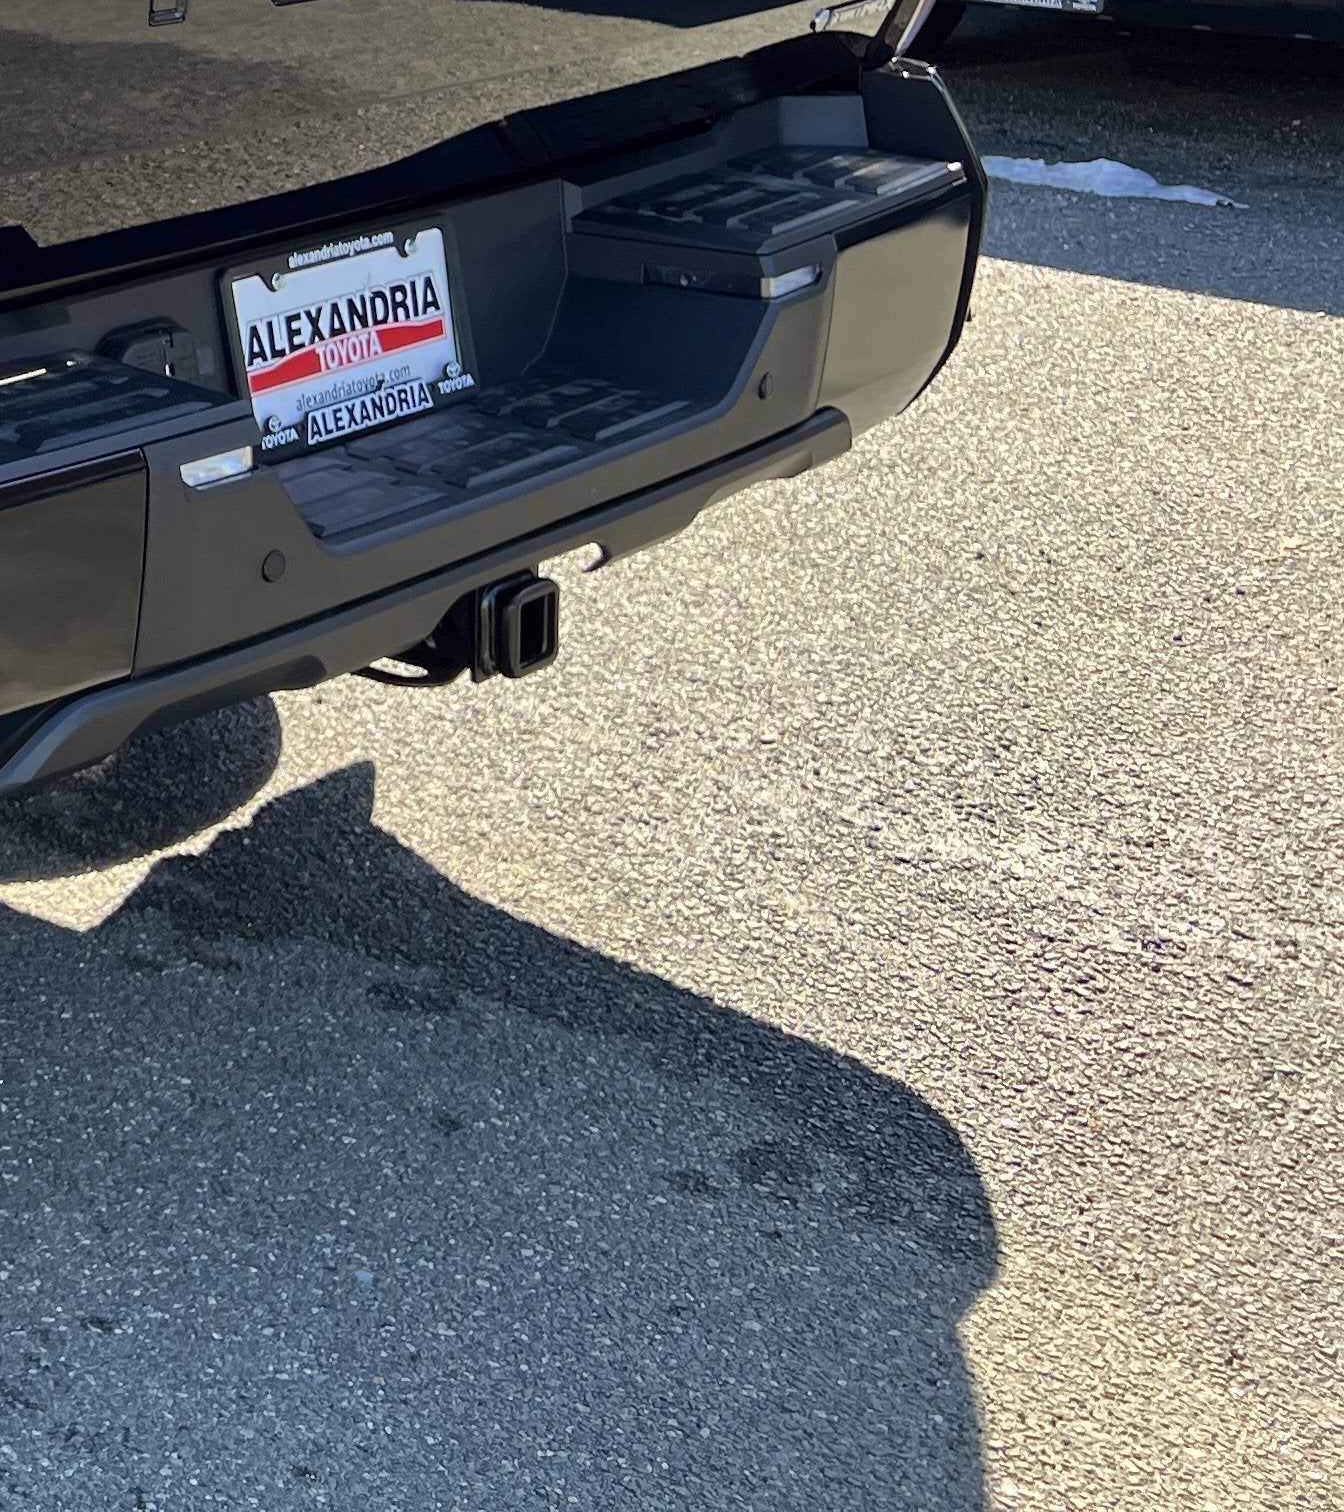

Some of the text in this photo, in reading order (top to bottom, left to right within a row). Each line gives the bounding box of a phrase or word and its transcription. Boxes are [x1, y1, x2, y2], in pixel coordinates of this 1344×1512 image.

[288, 230, 395, 269] alexandriatoyota.com
[246, 275, 442, 368] ALEXANDRIA
[315, 329, 383, 373] TOYOTA
[437, 373, 475, 395] TOYOTA
[310, 383, 431, 440] ALEXANDRIA
